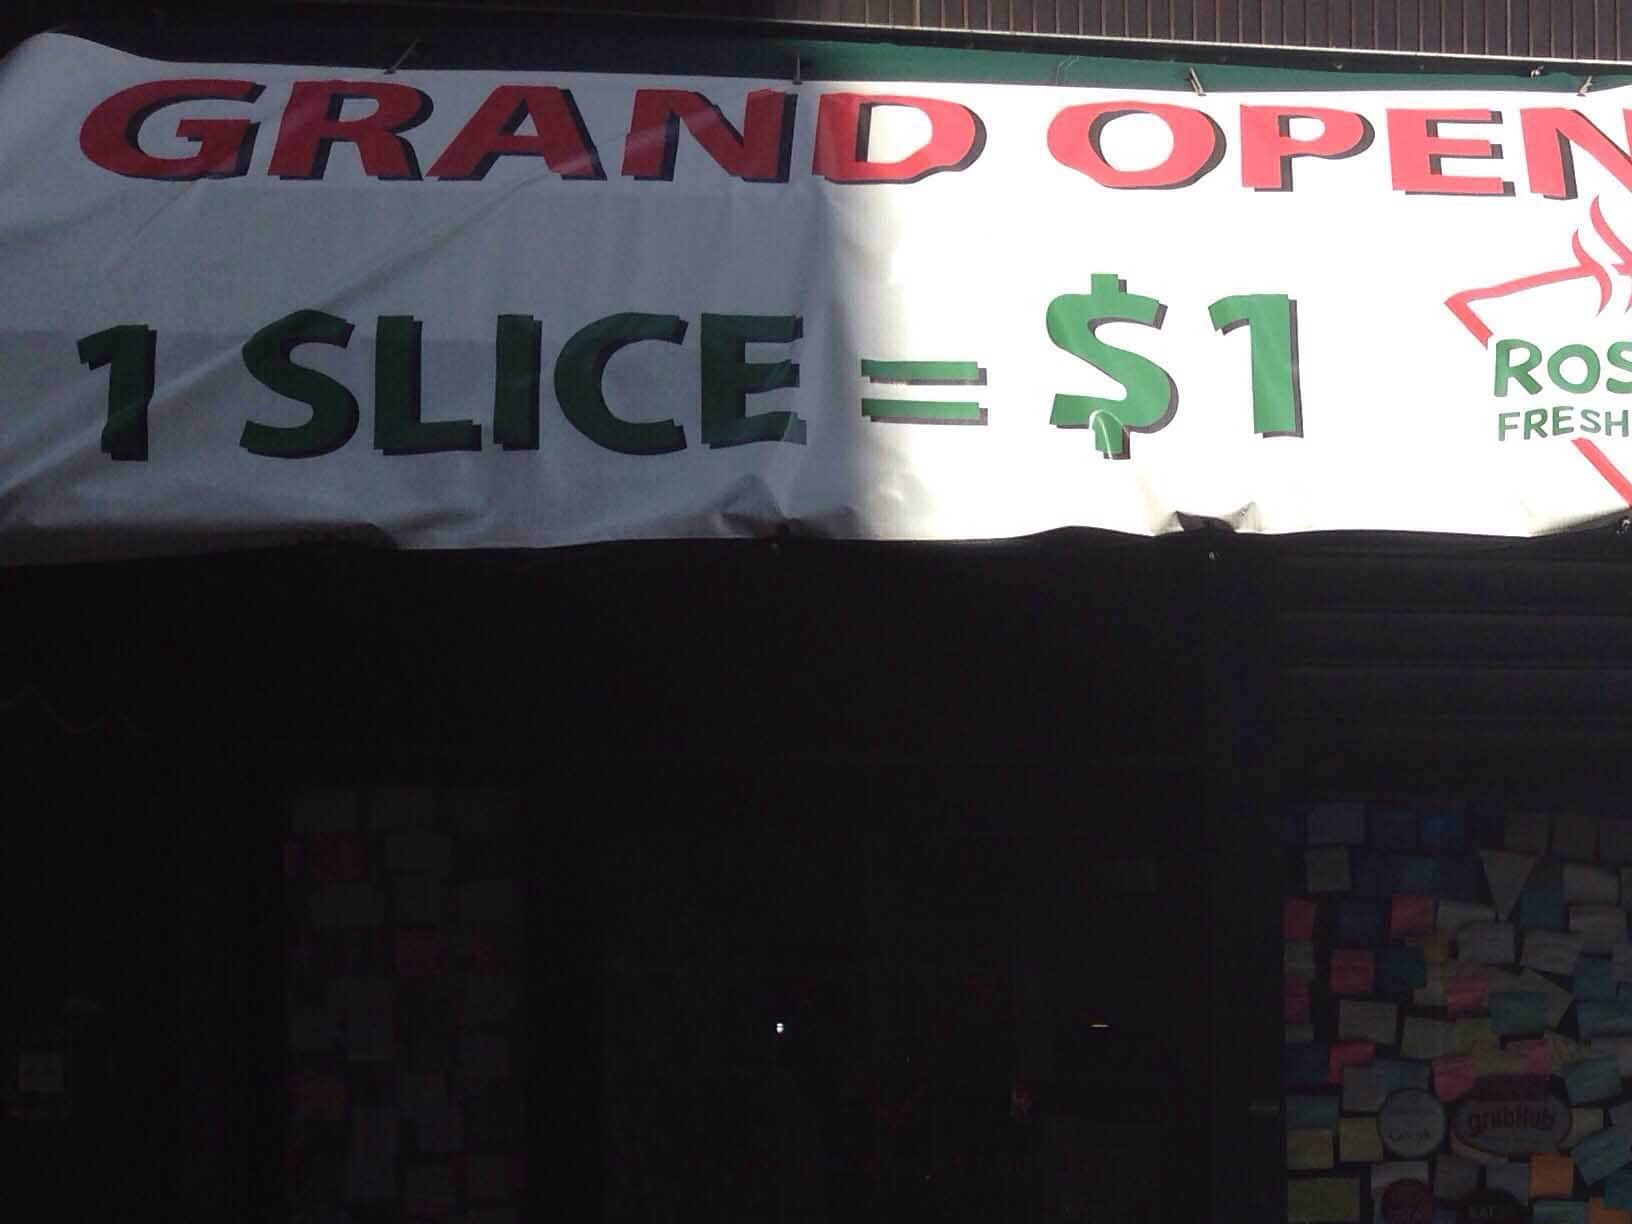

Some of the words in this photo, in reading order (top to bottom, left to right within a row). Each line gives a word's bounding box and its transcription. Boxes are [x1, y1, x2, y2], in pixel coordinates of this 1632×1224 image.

[79, 79, 988, 184] GRAND
[78, 324, 157, 461] 1
[239, 309, 808, 458] SLICE
[1046, 273, 1304, 459] $1
[1498, 405, 1630, 442] FRESH
